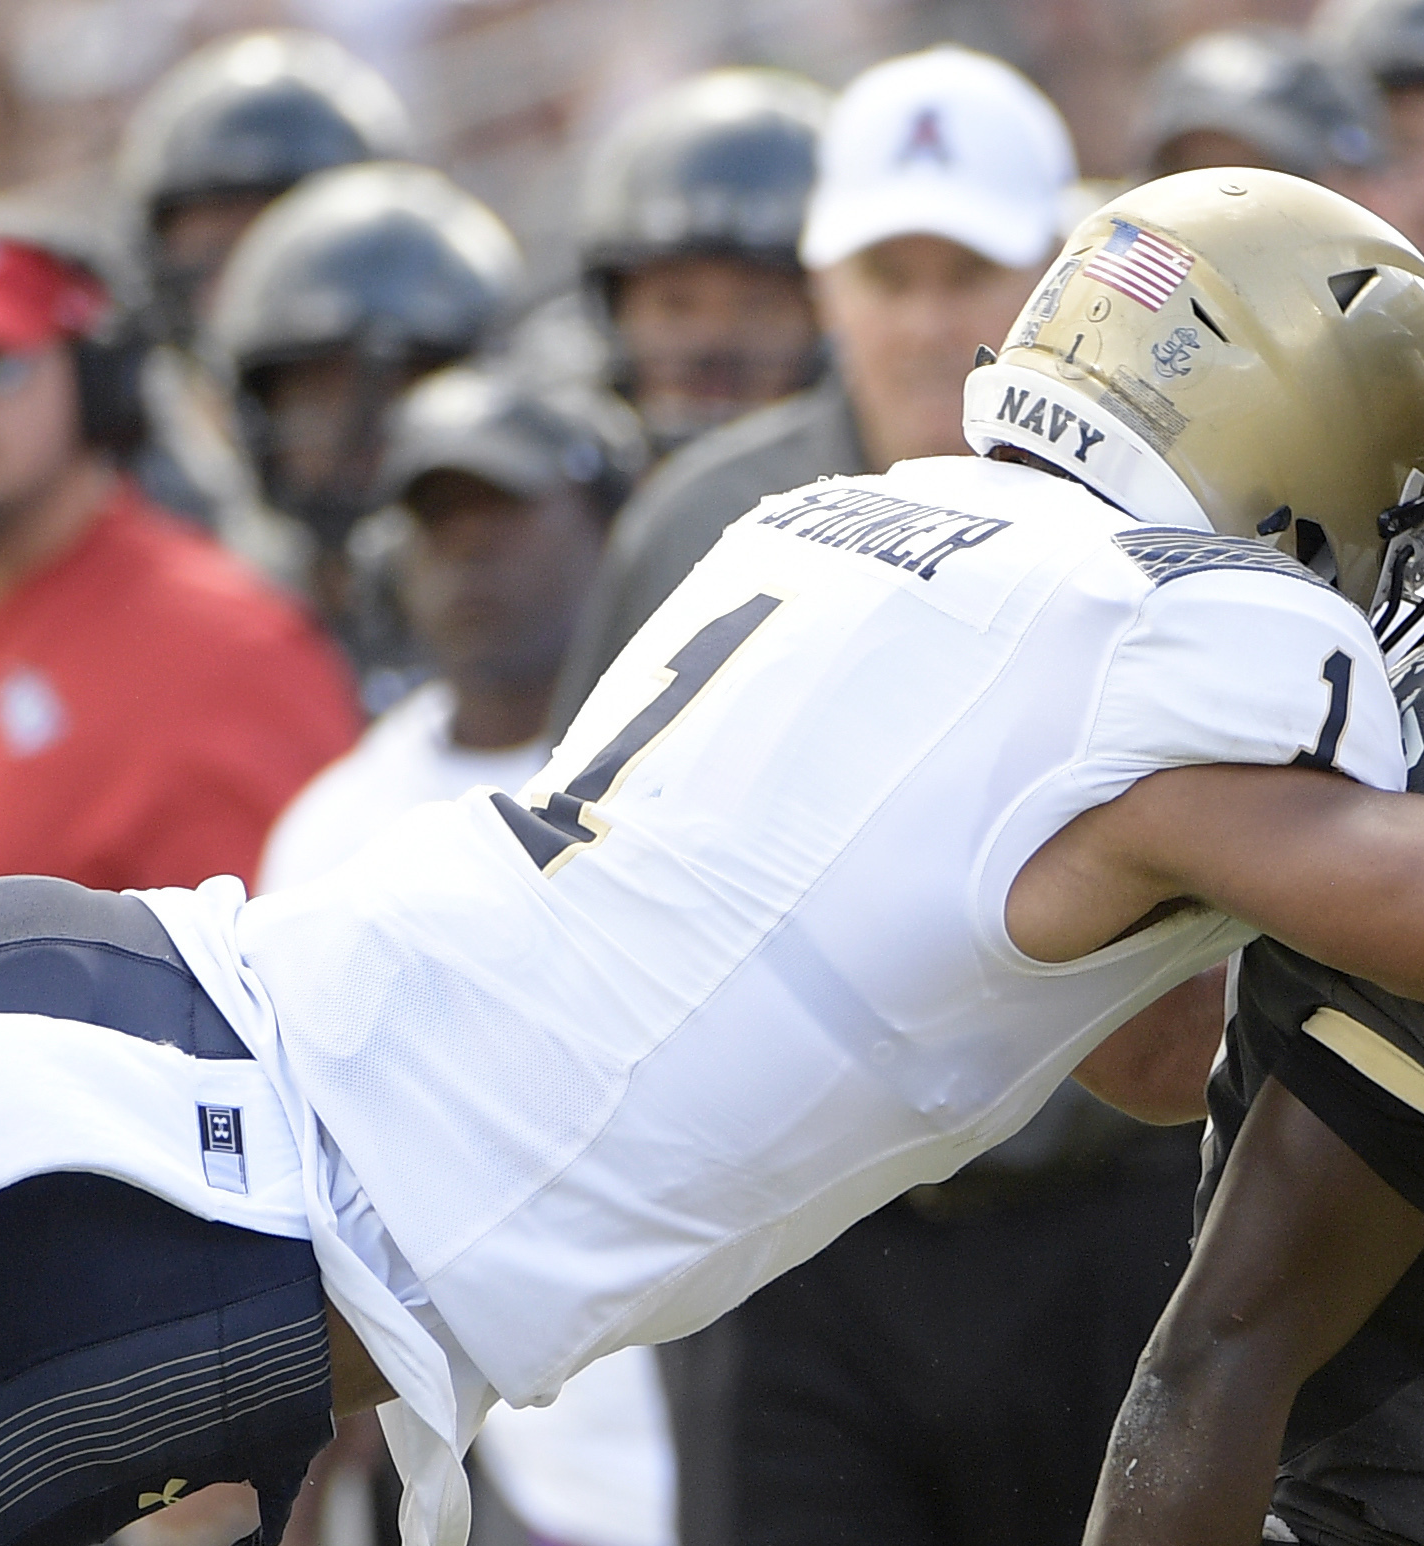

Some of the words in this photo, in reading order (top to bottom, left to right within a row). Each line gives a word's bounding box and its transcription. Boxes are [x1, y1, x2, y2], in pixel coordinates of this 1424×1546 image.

[996, 386, 1105, 463] NAVY
[757, 488, 1015, 581] SPRINGER
[487, 588, 801, 879] 1
[1289, 647, 1355, 770] 1
